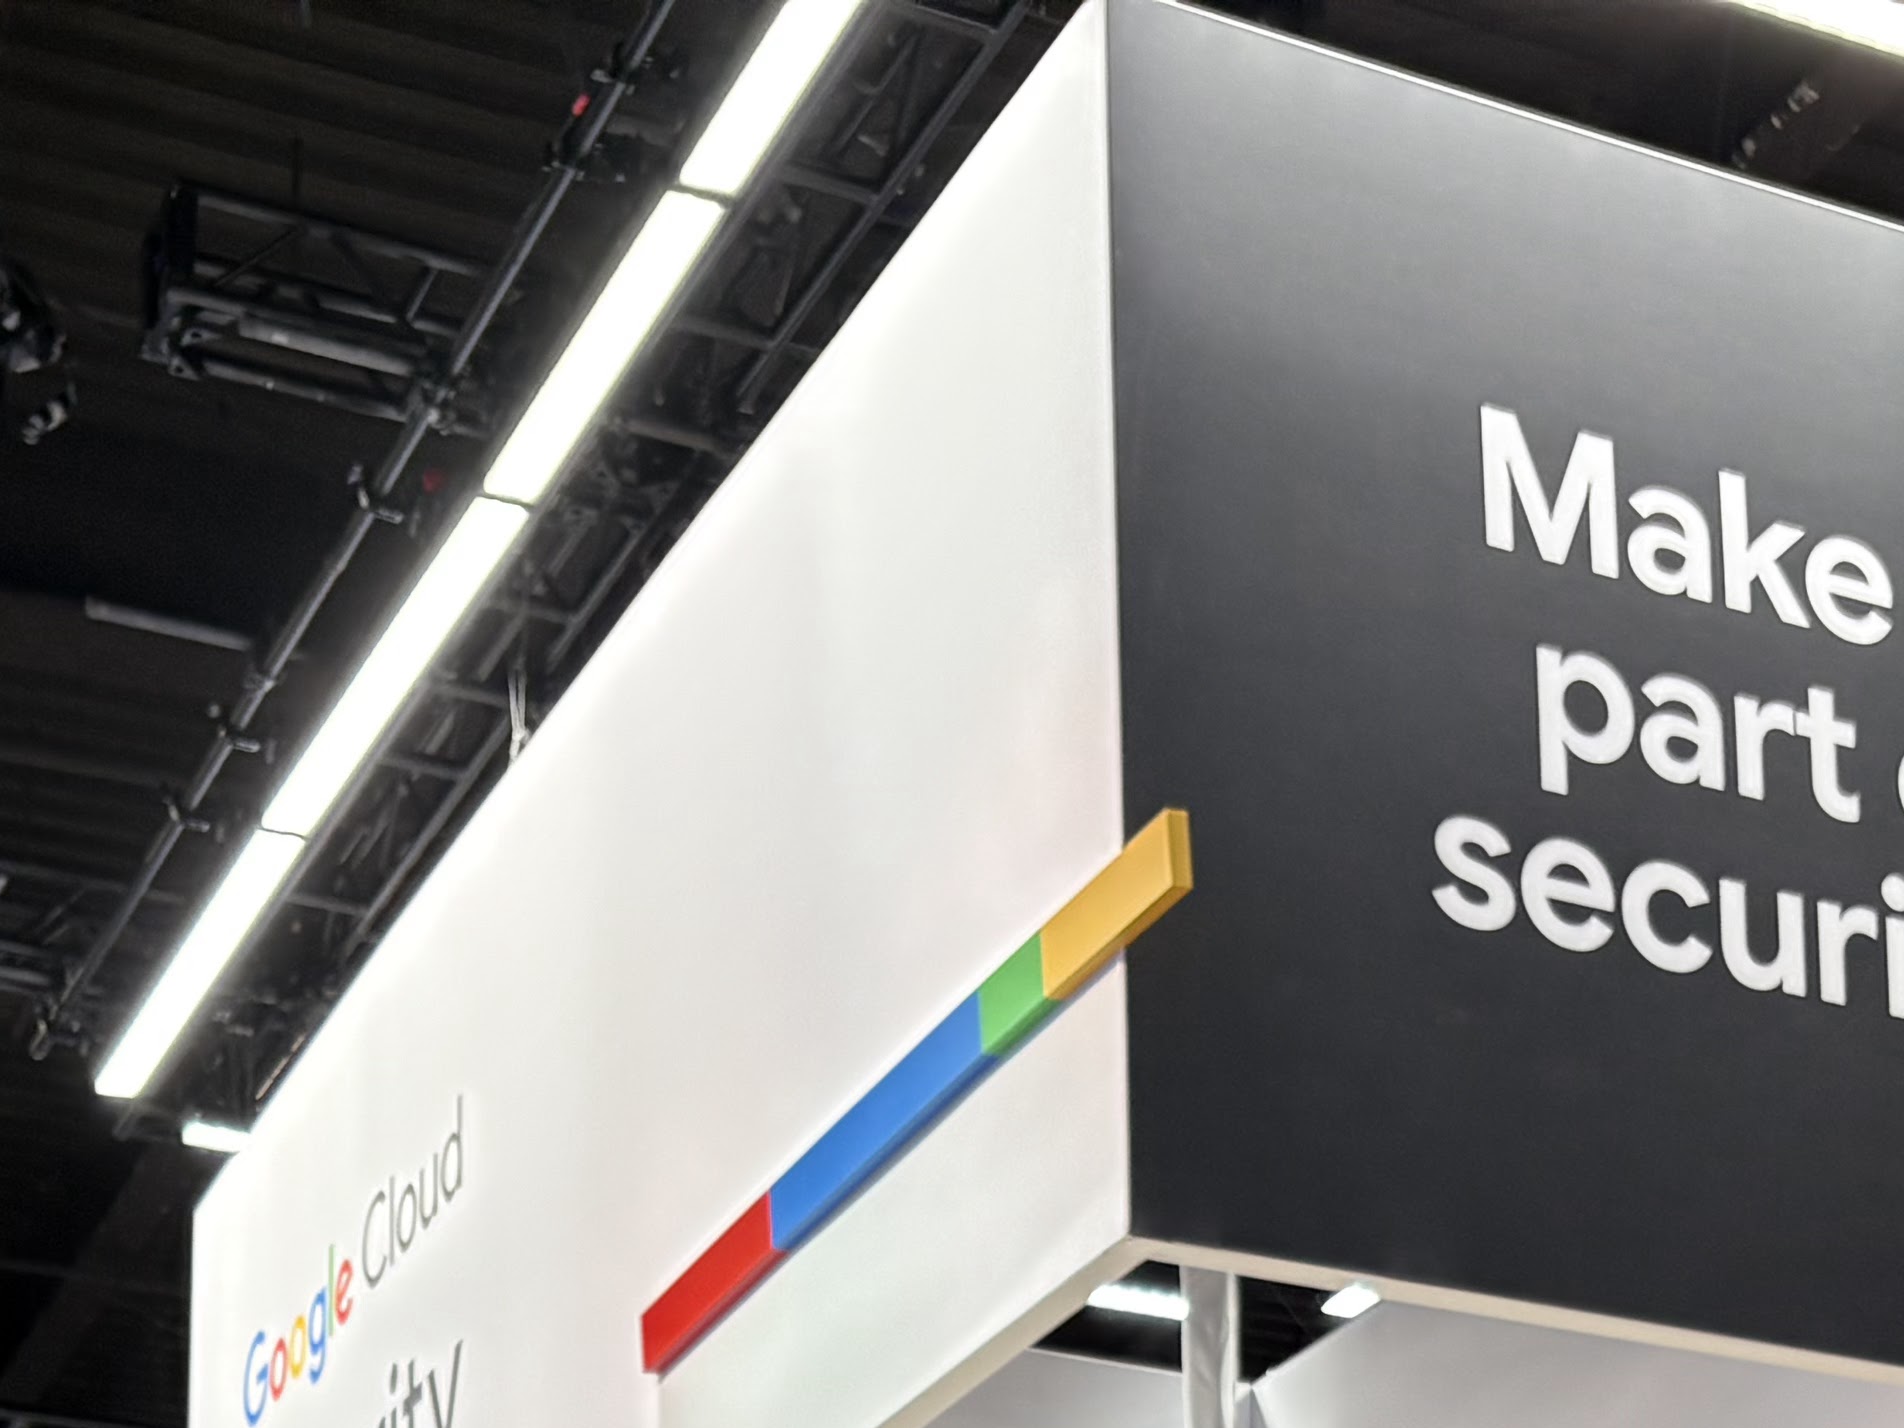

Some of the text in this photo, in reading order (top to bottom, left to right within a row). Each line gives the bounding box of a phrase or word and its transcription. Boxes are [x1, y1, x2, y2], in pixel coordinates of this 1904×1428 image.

[1480, 403, 1894, 646] Make
[1535, 643, 1861, 822] part
[243, 1094, 465, 1427] Google Cloud
